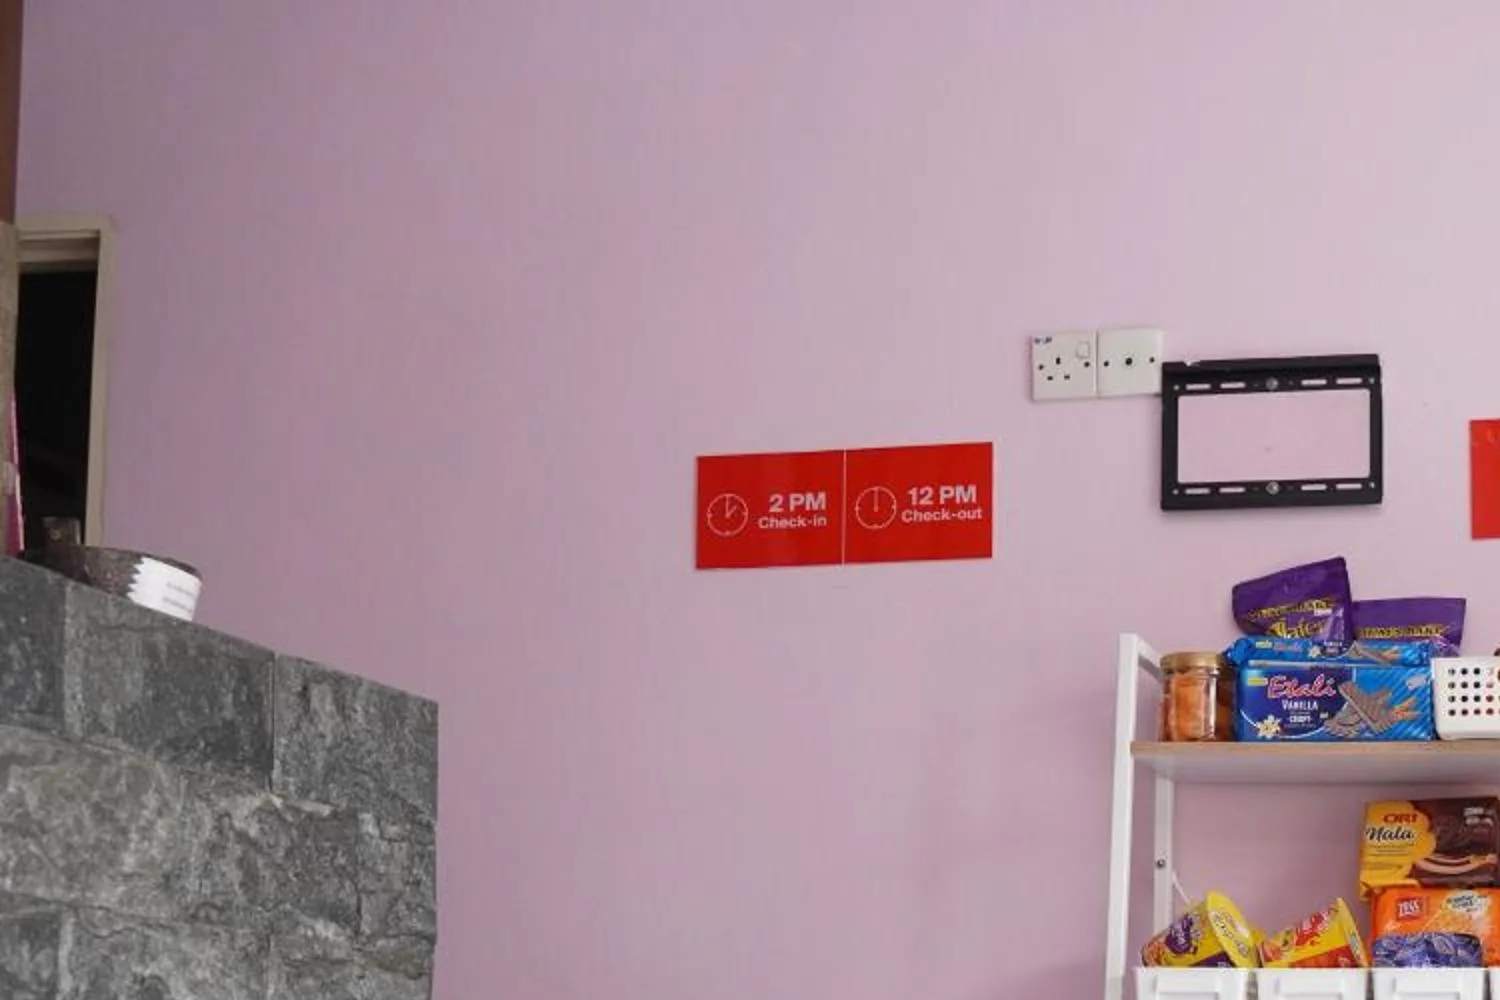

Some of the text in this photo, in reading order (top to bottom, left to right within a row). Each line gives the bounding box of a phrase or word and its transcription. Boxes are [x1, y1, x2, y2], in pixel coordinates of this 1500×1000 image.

[769, 492, 826, 513] 2 PM
[908, 485, 977, 505] 12 PM
[758, 515, 827, 529] Check-in
[902, 508, 983, 523] Check-out
